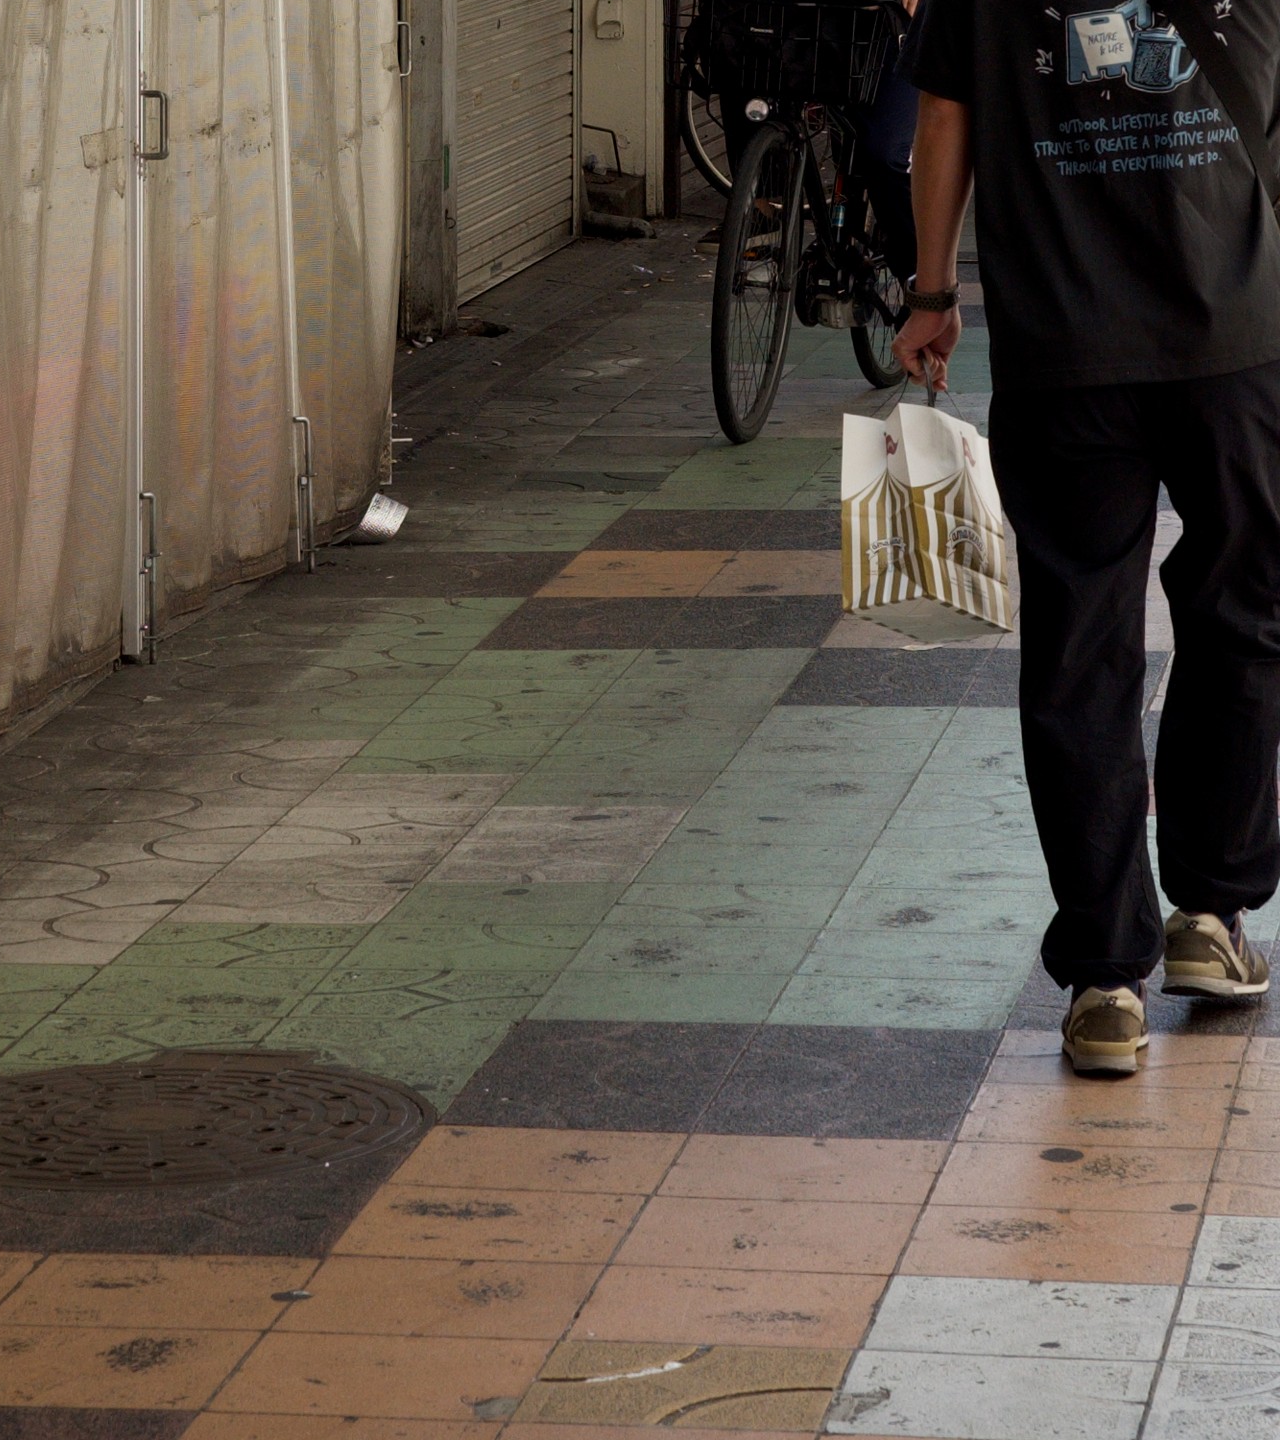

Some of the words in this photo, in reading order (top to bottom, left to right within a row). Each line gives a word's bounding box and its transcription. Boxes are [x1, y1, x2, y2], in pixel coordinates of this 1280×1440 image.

[1087, 31, 1119, 45] NATURE
[1107, 42, 1125, 55] LIFE
[1059, 117, 1109, 135] OUTDOOR
[1112, 112, 1169, 132] LIFESTYLE
[1173, 107, 1222, 128] CREATOR
[1034, 139, 1074, 158] STRIVE
[1075, 139, 1091, 154] TO
[1094, 135, 1139, 154] CREATE
[1142, 134, 1151, 148] A
[1154, 130, 1203, 148] POSITIVE
[1056, 160, 1107, 176] THROUGH
[1112, 153, 1184, 172] EVERYTHING
[1188, 153, 1205, 166] WE
